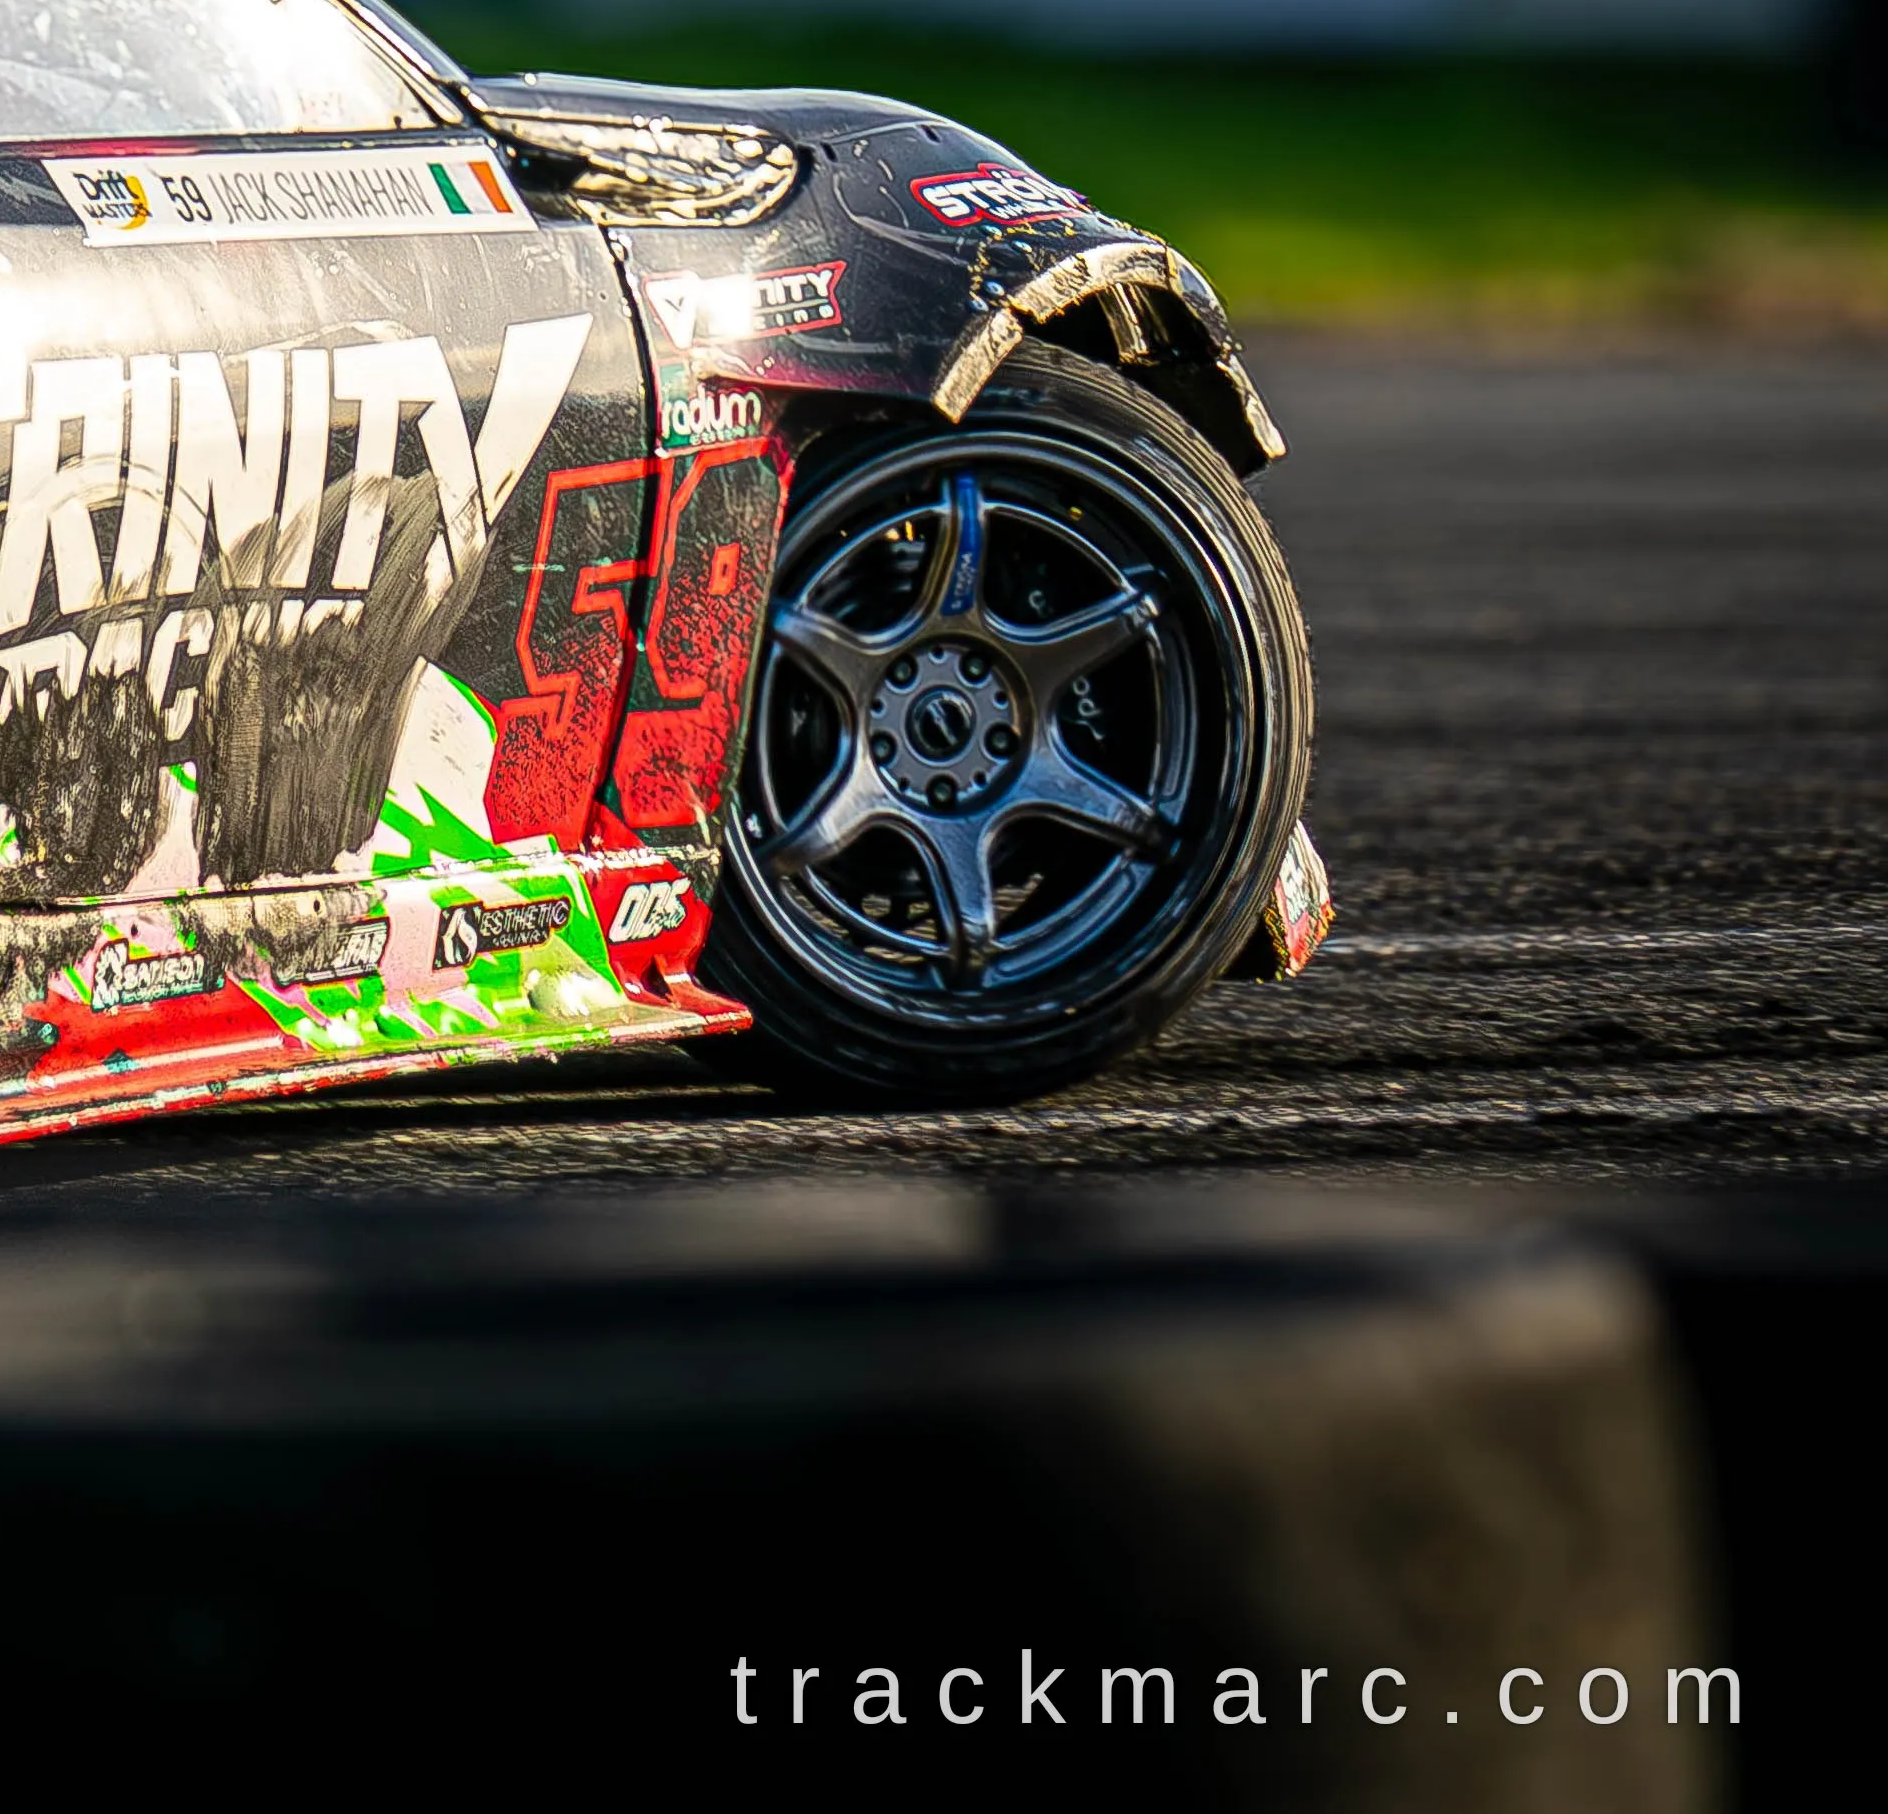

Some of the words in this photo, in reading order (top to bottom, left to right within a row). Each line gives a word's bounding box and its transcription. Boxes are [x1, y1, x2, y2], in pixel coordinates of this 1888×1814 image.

[74, 169, 139, 202] Drift
[159, 175, 213, 223] 59
[207, 171, 278, 225] JACK
[275, 167, 435, 222] SHANAHAN
